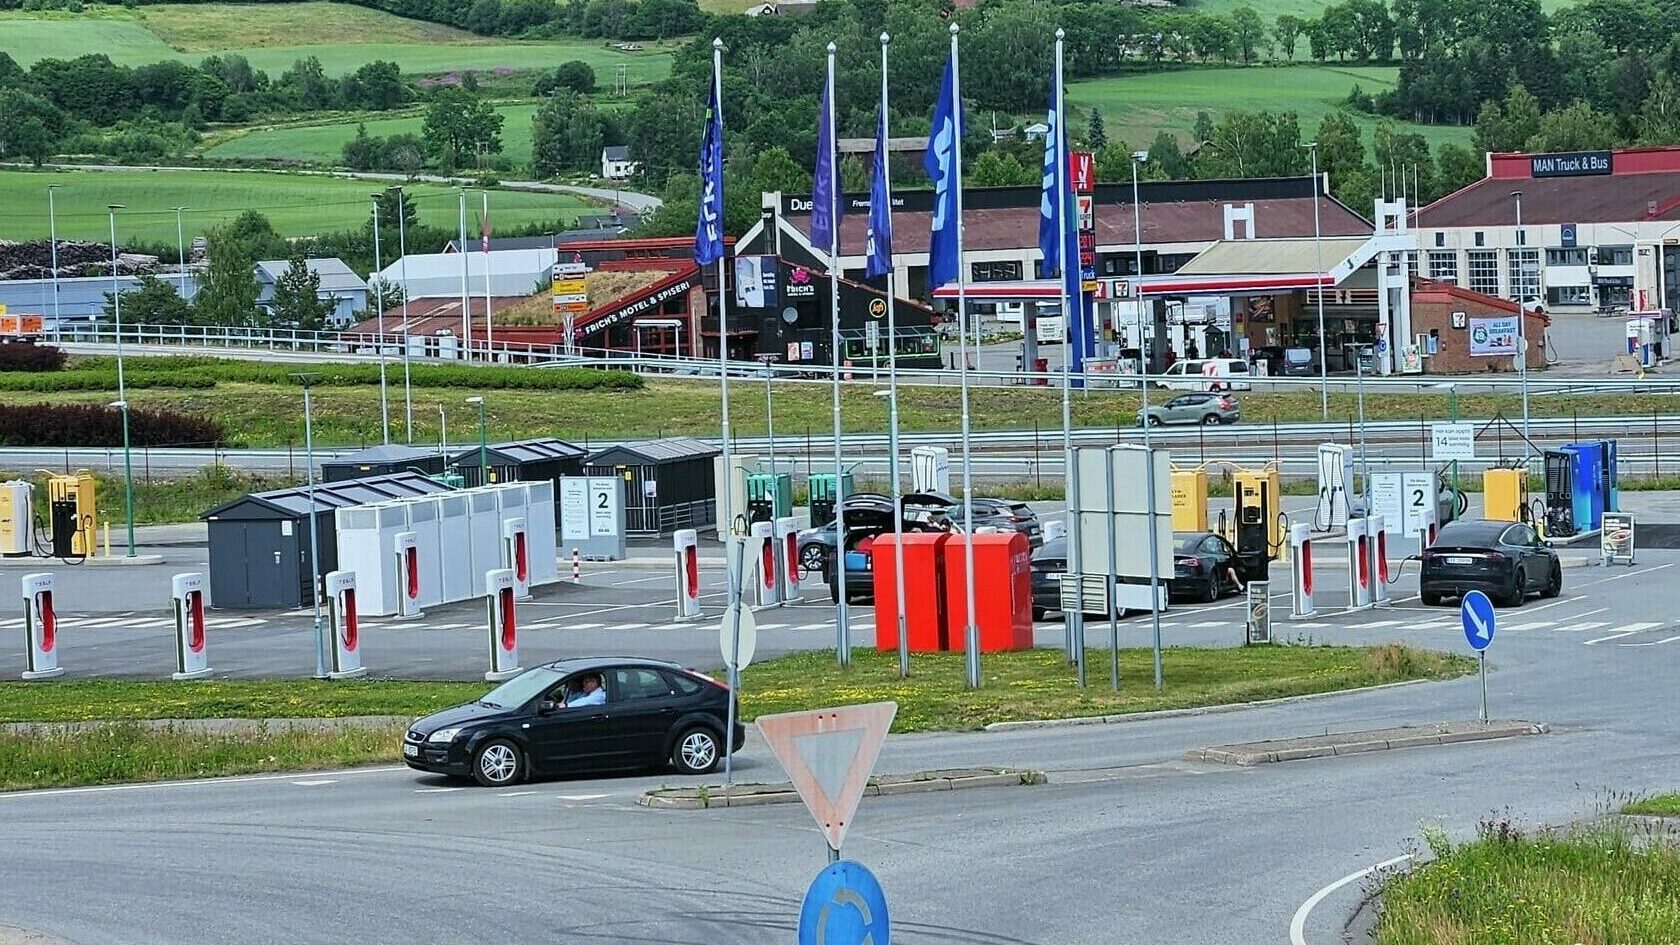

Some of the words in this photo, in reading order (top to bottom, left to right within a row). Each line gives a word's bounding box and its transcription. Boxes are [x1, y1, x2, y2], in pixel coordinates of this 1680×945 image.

[1533, 158, 1554, 172] MAN
[1556, 157, 1580, 171] Truck
[1581, 156, 1589, 170] &
[1590, 156, 1608, 169] Bus
[585, 314, 618, 335] FRICH'S
[619, 300, 650, 319] MOTEL
[649, 296, 657, 305] &
[657, 281, 690, 301] SPISERI
[1436, 436, 1448, 447] 14
[597, 492, 609, 509] 2
[1412, 489, 1425, 507] 2
